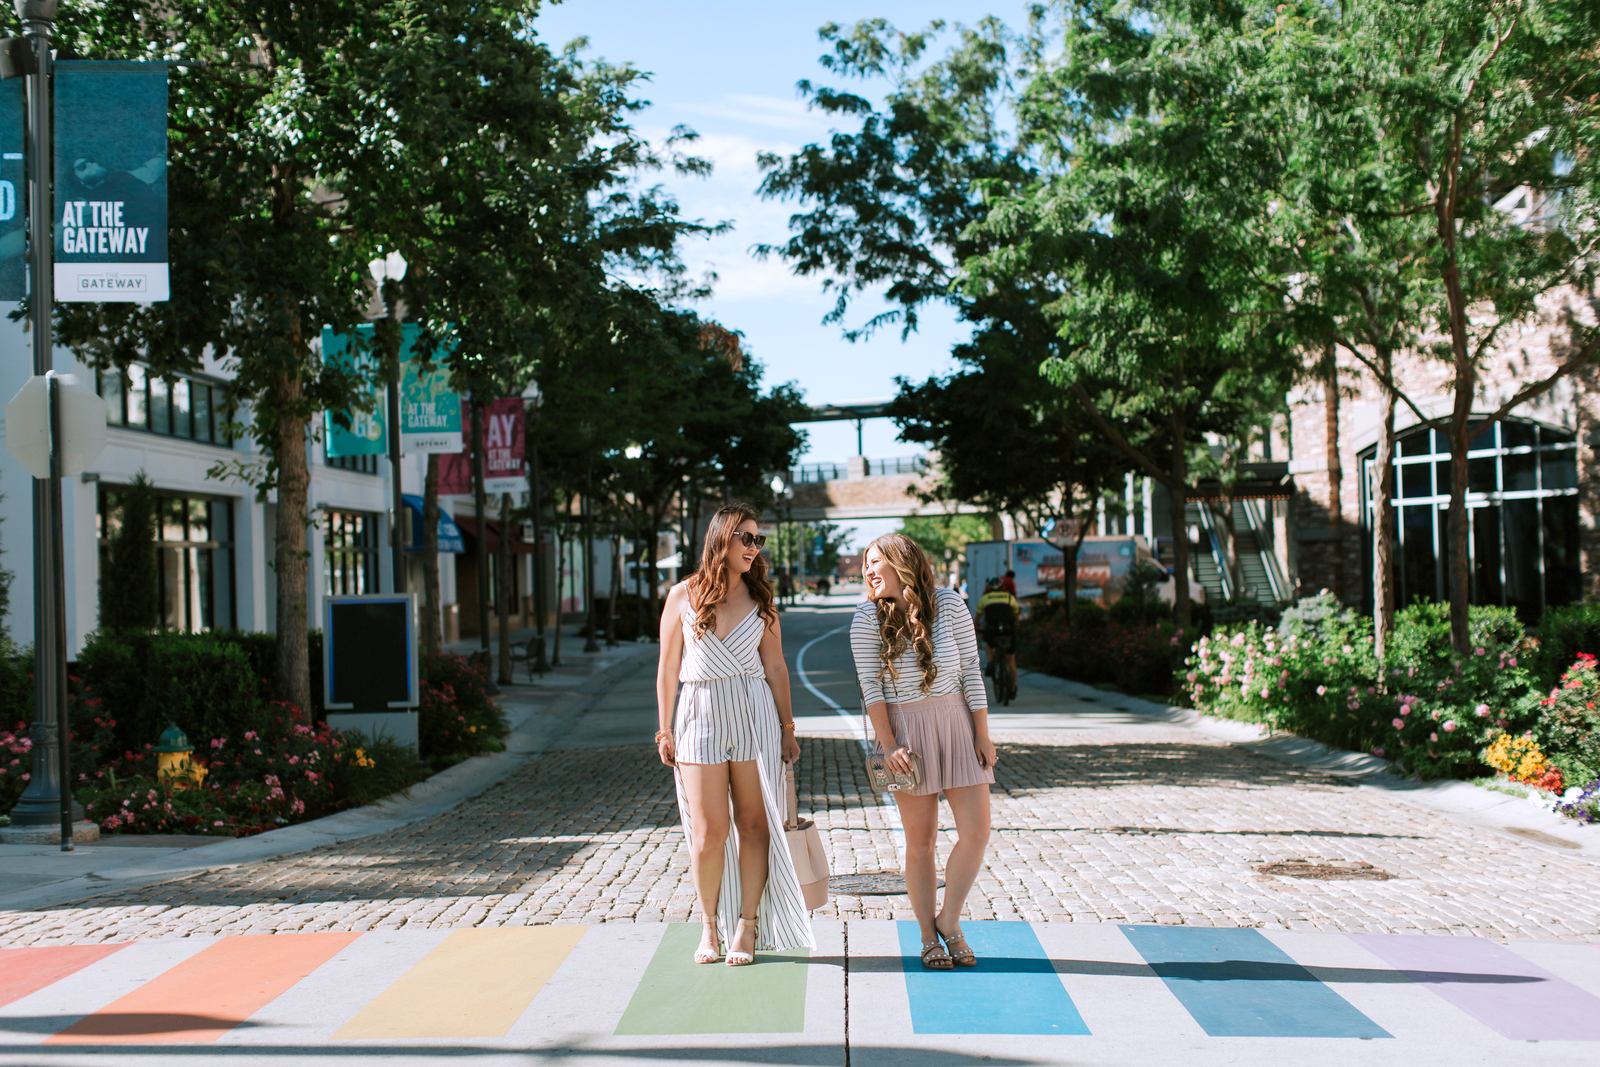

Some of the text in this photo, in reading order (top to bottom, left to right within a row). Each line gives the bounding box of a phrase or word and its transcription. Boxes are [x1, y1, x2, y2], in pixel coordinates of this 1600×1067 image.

[62, 201, 125, 227] AT THE
[63, 227, 149, 254] GATEWAY
[81, 279, 142, 289] GATEWAY
[408, 402, 436, 416] AT THE
[408, 414, 447, 428] GATEWAY
[487, 414, 515, 447] AY
